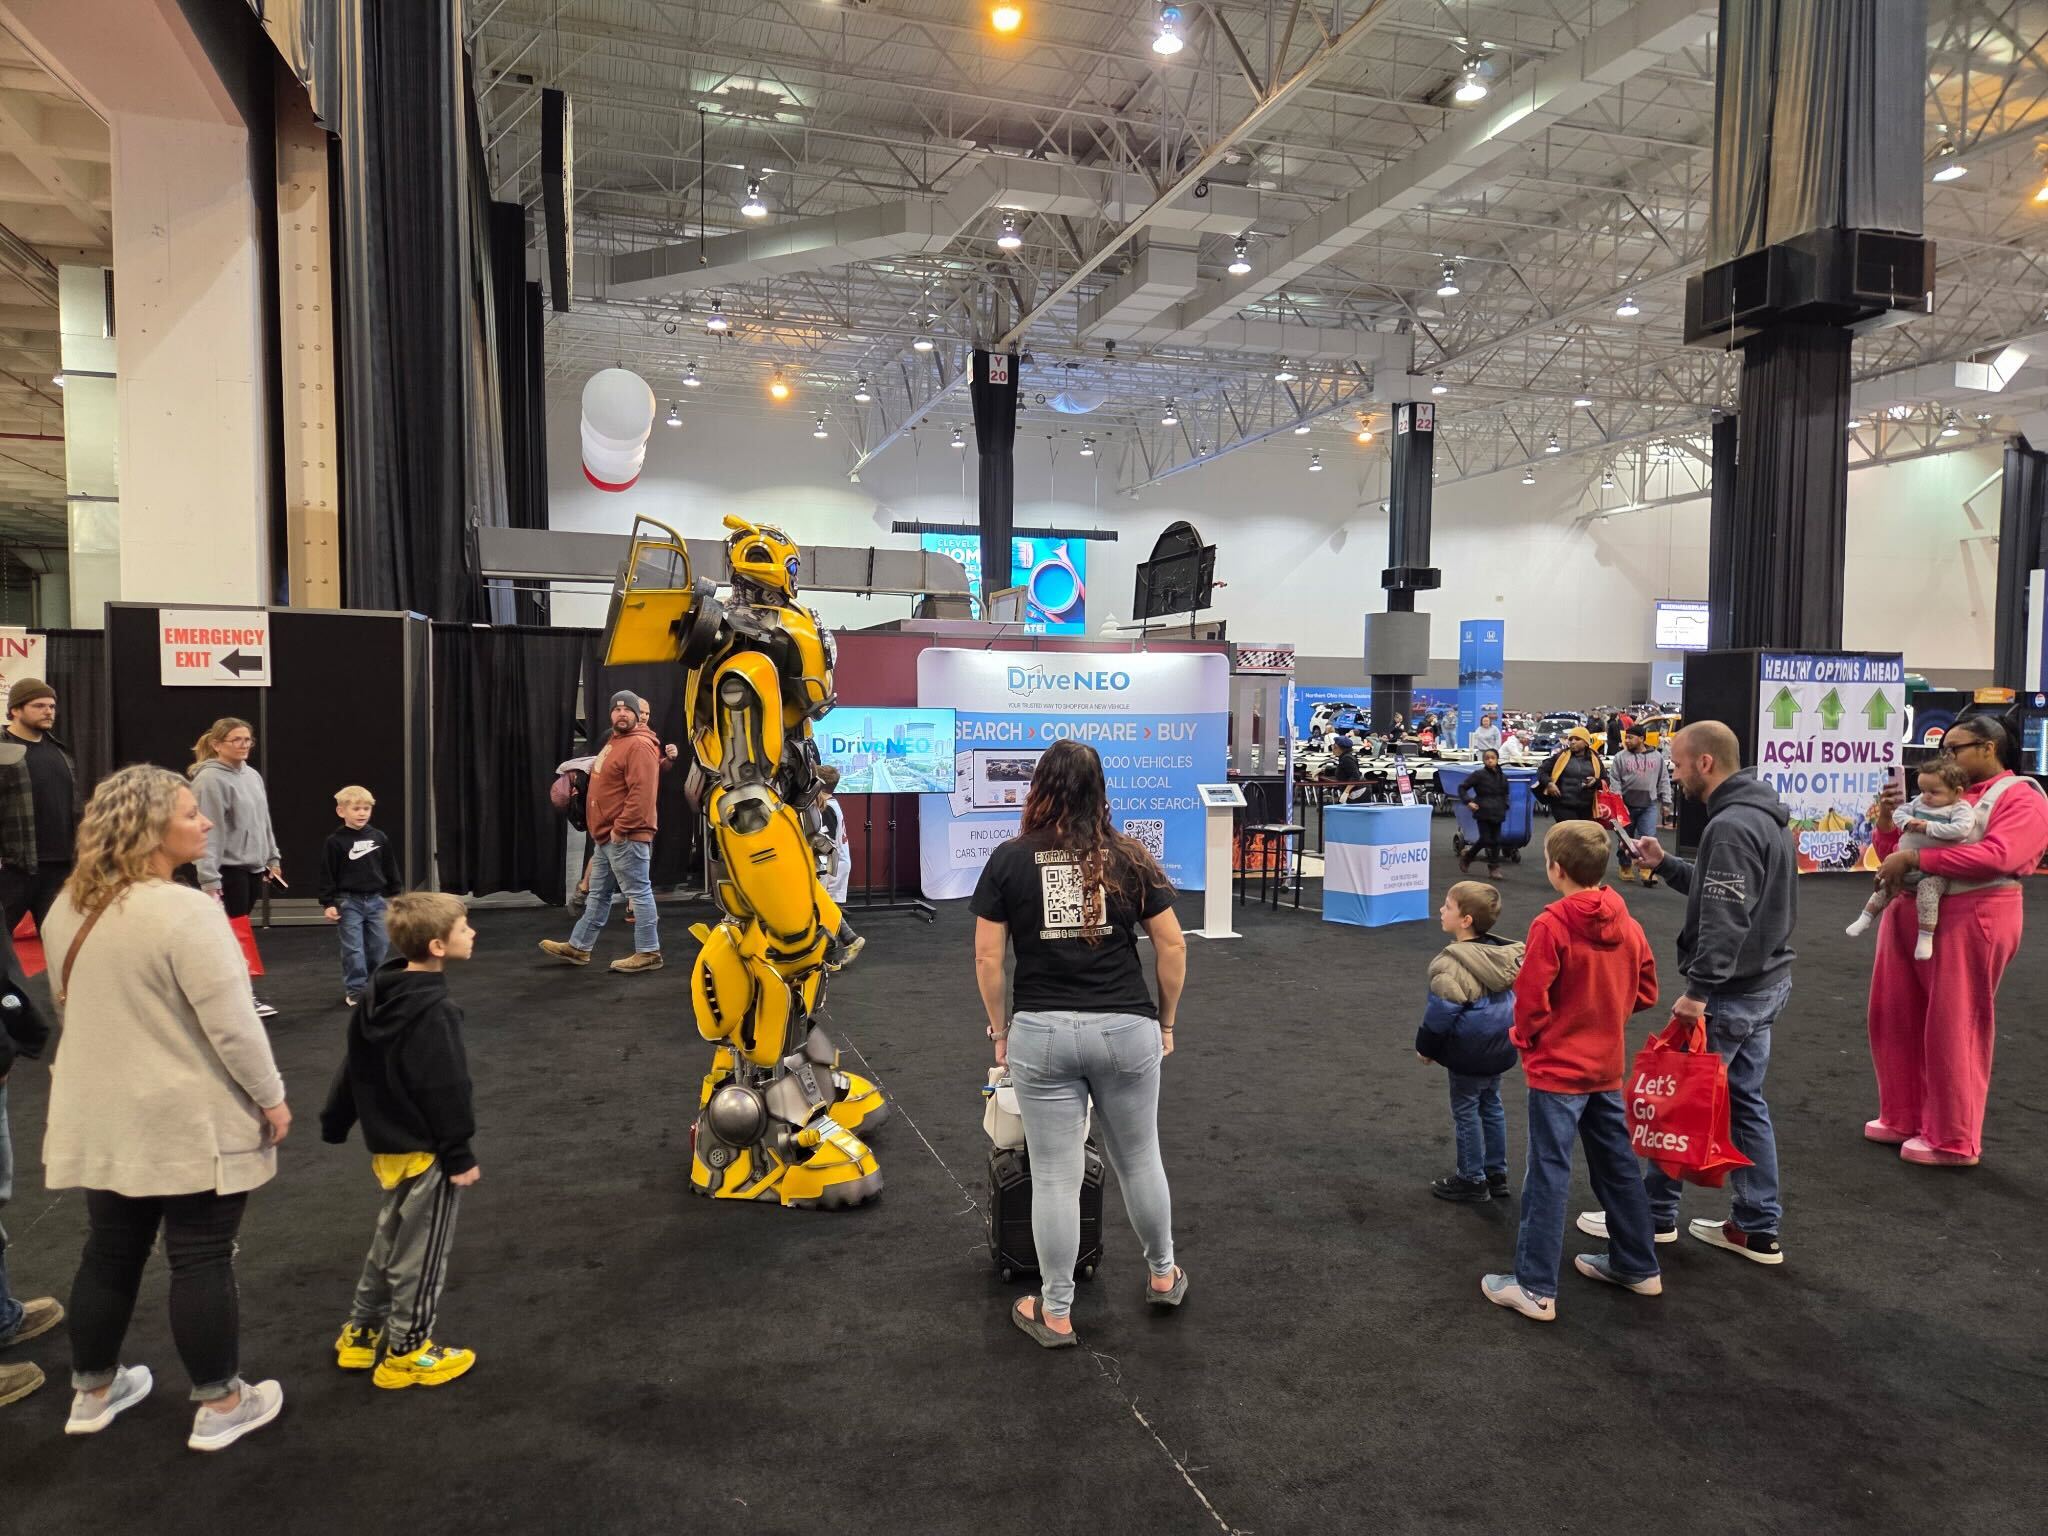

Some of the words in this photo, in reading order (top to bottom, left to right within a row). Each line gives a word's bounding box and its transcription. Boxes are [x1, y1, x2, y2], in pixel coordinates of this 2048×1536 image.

[994, 356, 1003, 367] Y
[991, 370, 1007, 381] 20
[1421, 405, 1429, 416] Y
[1417, 418, 1432, 429] 22
[164, 627, 265, 646] EMERGENCY
[175, 651, 212, 668] EXIT
[1765, 659, 1812, 680] HEALTHY
[1814, 661, 1859, 681] OPTIONS
[1863, 662, 1900, 682] AHEAD
[1009, 668, 1131, 691] DriveNEO
[955, 720, 1022, 741] SEARCH
[1040, 721, 1137, 741] COMPARE
[1157, 722, 1198, 741] BUY
[832, 737, 929, 753] DriveNEO
[1763, 735, 1816, 769] AÇAÍ
[1821, 741, 1894, 763] BOWLS
[1132, 755, 1193, 769] VEHICLES
[1105, 776, 1129, 789] ALL
[1131, 776, 1173, 789] LOCAL
[1111, 797, 1147, 810] CLICK
[1149, 797, 1200, 810] SEARCH
[970, 830, 988, 841] FIND
[989, 829, 1014, 839] LOCAL
[1800, 832, 1847, 851] SMOOTH
[1380, 848, 1428, 865] DriveNEO
[1810, 842, 1850, 860] RIDER
[1633, 1072, 1677, 1097] Let's
[1632, 1097, 1656, 1121] Go
[1631, 1123, 1690, 1153] Places
